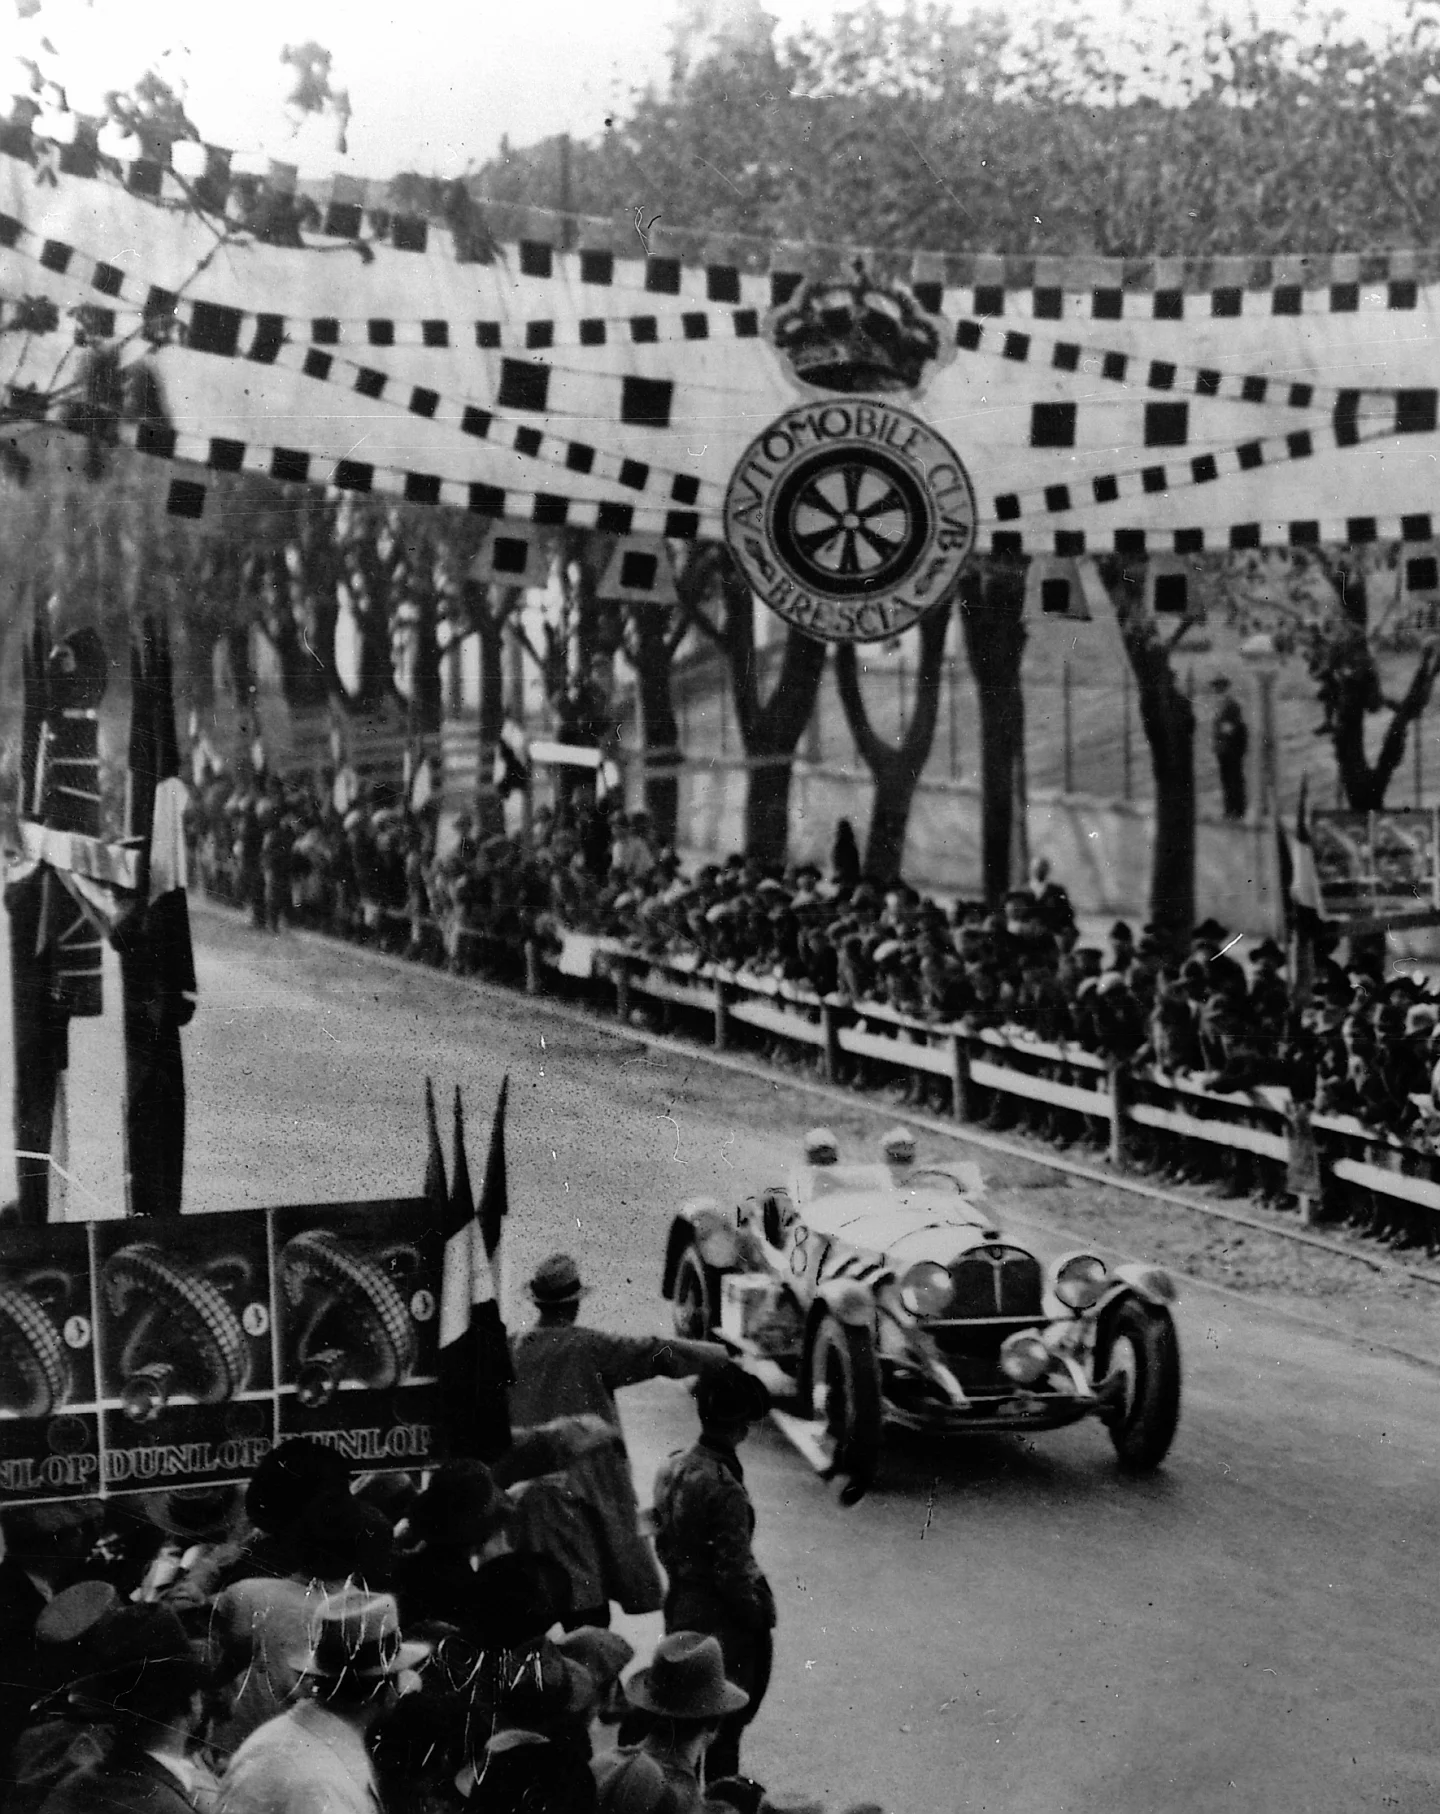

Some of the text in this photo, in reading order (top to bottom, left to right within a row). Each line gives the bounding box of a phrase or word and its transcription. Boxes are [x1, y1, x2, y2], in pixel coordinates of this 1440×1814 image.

[767, 576, 924, 635] BRESCIA
[102, 1438, 270, 1482] DUNLOP
[278, 1425, 431, 1459] NLOP
